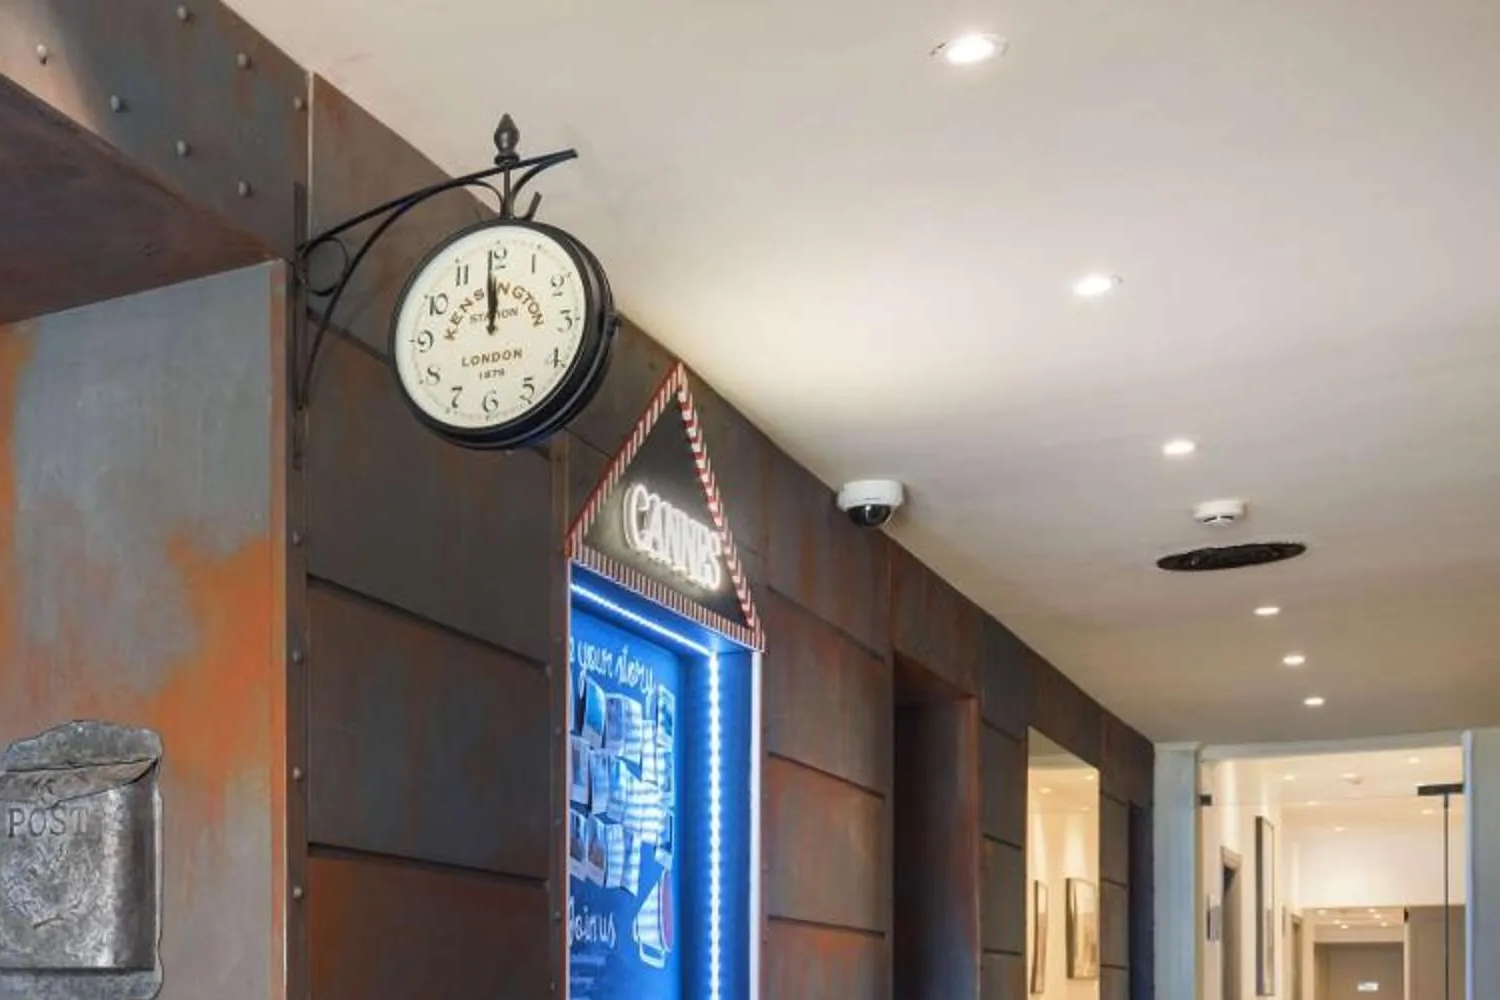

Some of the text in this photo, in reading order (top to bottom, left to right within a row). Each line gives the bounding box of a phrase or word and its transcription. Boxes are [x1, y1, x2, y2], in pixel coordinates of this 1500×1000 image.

[455, 263, 469, 287] 11
[551, 274, 565, 297] 2
[428, 291, 449, 317] 10
[443, 281, 545, 341] KENSNGTON
[557, 309, 573, 333] 3
[416, 329, 435, 353] 9
[461, 348, 523, 368] LONDON
[547, 346, 566, 369] 4
[426, 364, 441, 387] 8
[449, 385, 464, 409] 7
[482, 388, 500, 415] 6
[519, 376, 536, 405] 5
[7, 805, 92, 838] POST
